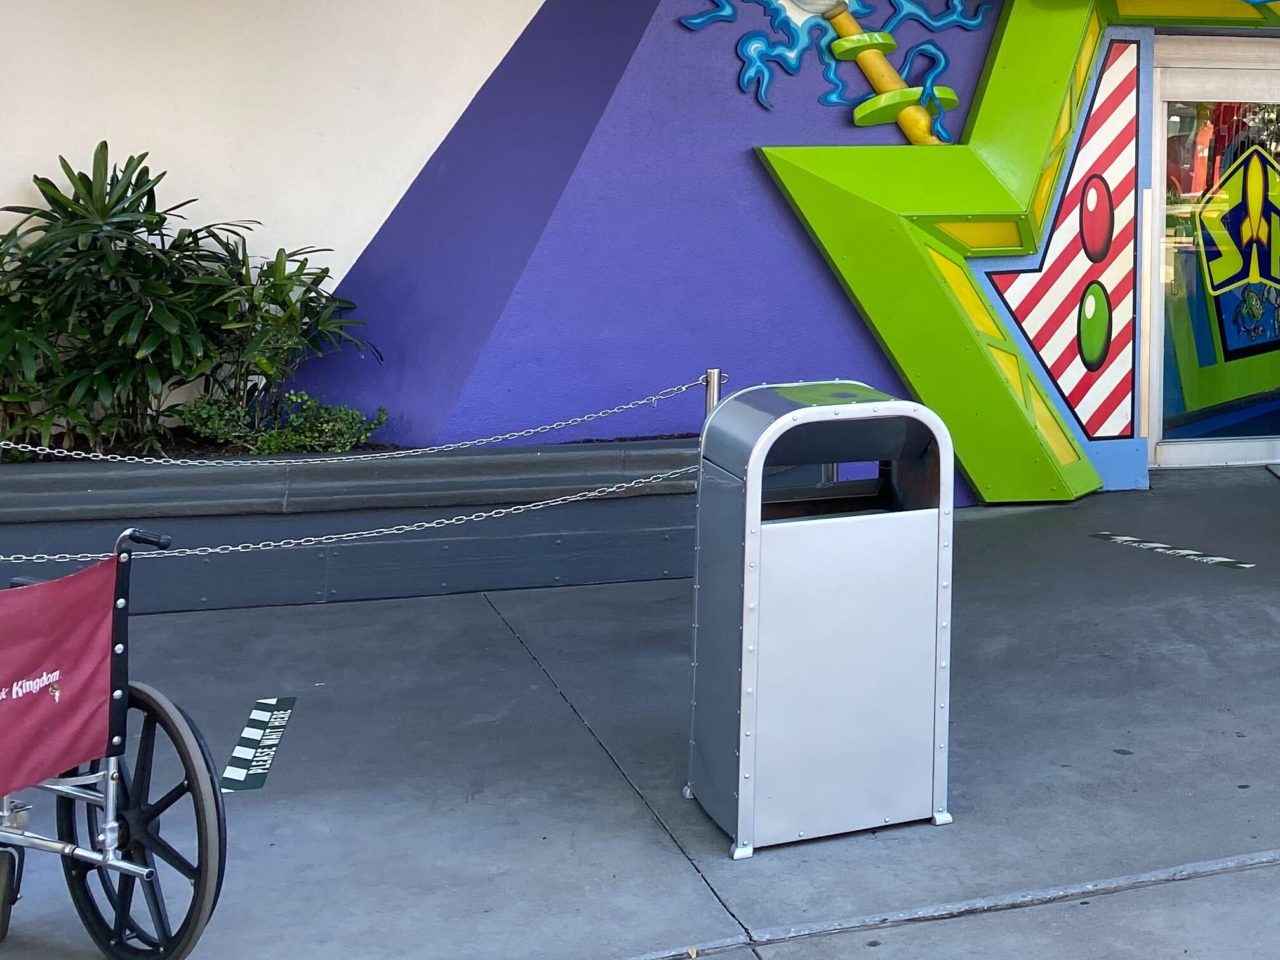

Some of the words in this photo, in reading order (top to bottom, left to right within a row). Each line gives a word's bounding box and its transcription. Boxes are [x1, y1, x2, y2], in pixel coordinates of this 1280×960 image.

[12, 670, 60, 699] Kingdom
[267, 709, 292, 727] HERE
[259, 728, 284, 746] WAIT
[248, 746, 277, 774] PLEASE
